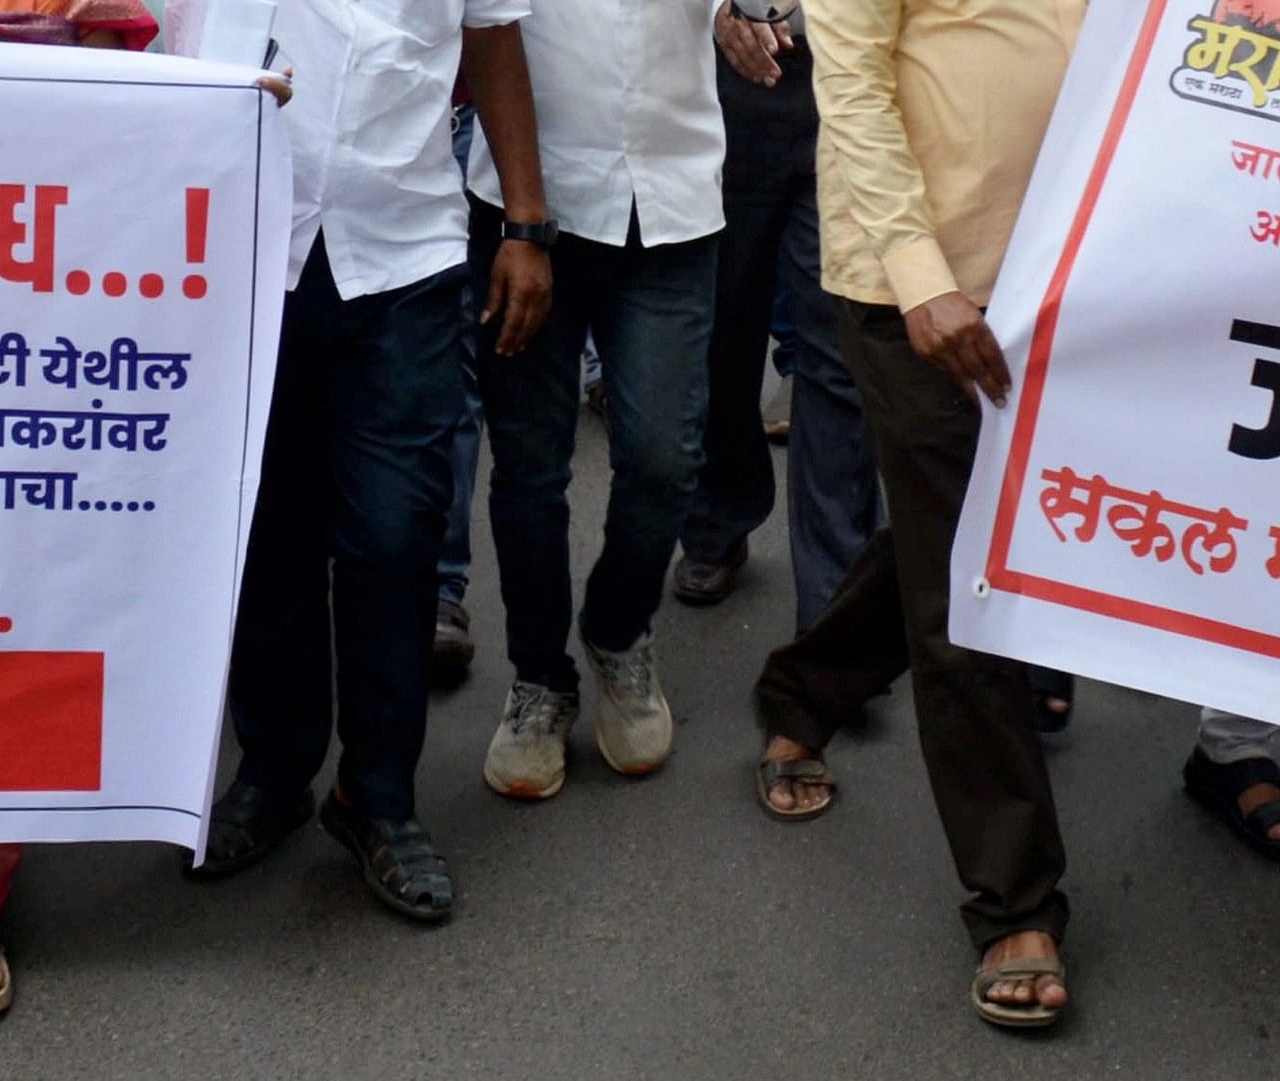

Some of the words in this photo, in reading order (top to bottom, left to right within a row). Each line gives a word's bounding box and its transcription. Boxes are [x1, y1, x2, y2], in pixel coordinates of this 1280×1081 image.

[1208, 81, 1243, 101] मराठा
[40, 336, 191, 391] येथील
[1038, 465, 1248, 575] सकल
